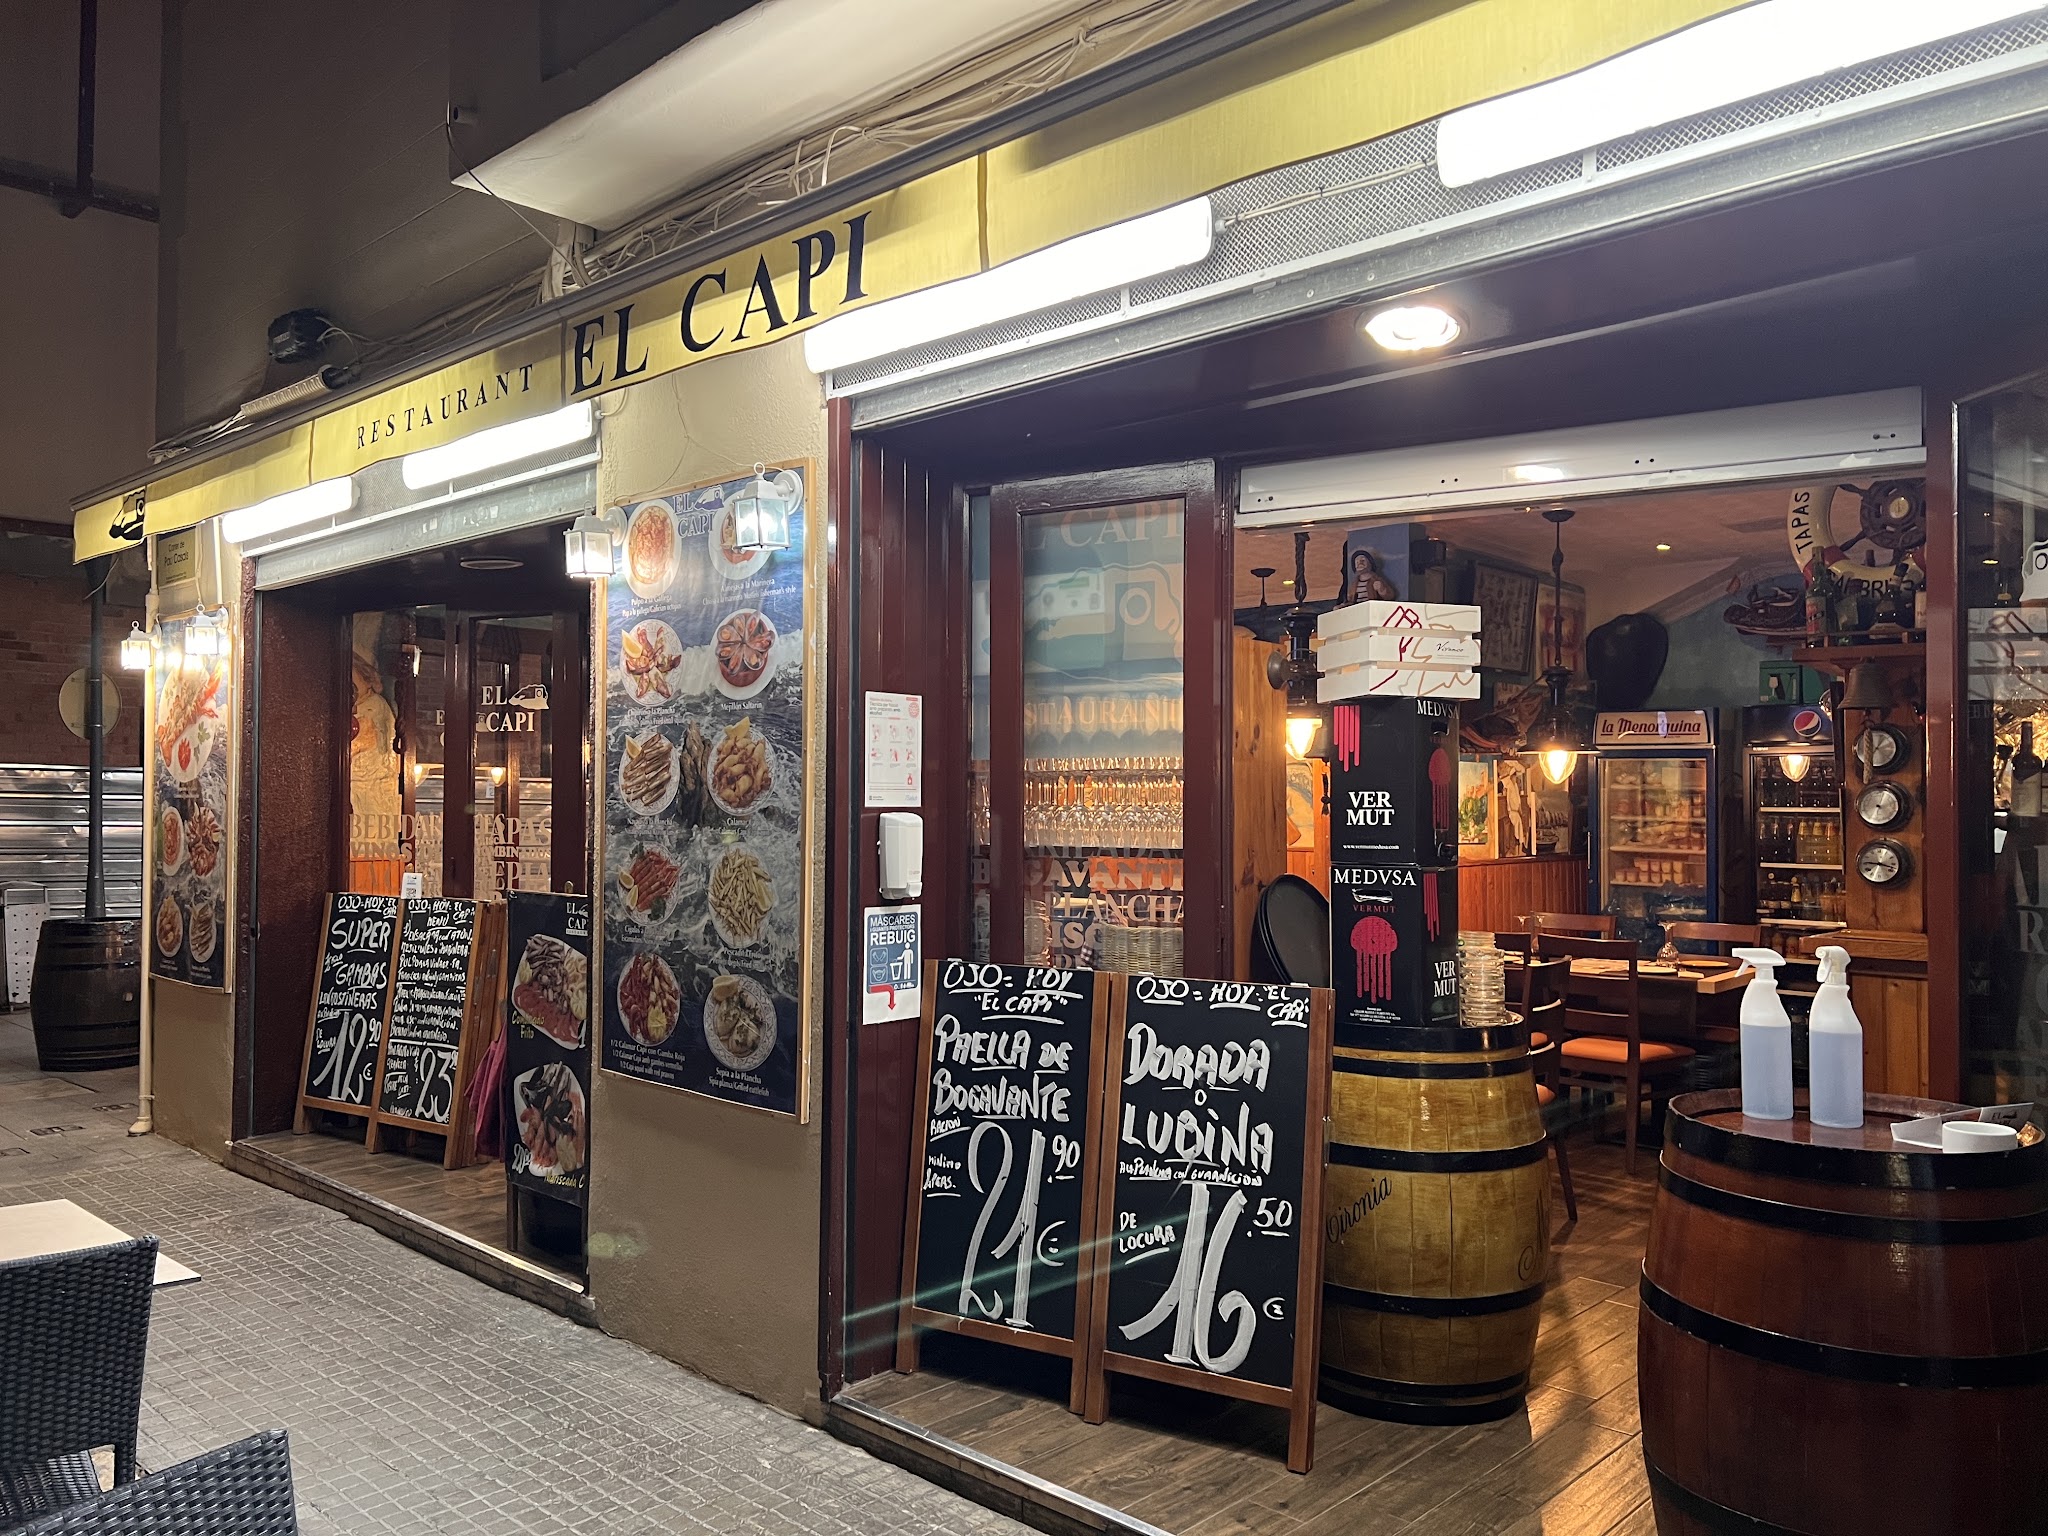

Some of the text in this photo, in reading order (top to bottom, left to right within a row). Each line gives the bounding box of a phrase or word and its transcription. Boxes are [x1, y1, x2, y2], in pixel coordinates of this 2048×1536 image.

[570, 210, 872, 396] EL CAPI
[357, 364, 533, 450] RESTAURANT
[673, 492, 694, 515] EL
[678, 513, 714, 538] CAPI
[1791, 491, 1813, 555] TAPAS
[481, 685, 508, 706] EL
[486, 712, 535, 732] CAPI
[1602, 719, 1614, 733] la
[1348, 791, 1392, 808] VER
[1346, 809, 1395, 826] MUT
[1334, 869, 1417, 886] MEDVSA
[567, 902, 578, 915] EL
[1352, 904, 1396, 913] VERMUT
[331, 916, 391, 952] SUPER
[870, 930, 915, 946] REBUIG
[336, 962, 387, 989] GAMBAS
[1026, 967, 1073, 991] HOY
[1434, 960, 1456, 979] VER
[1433, 978, 1457, 998] MUT
[935, 1014, 1073, 1071] PAELLA DE
[1123, 1023, 1270, 1092] DORADA
[933, 1067, 1071, 1122] BOGAVANTE
[1120, 1212, 1137, 1231] DE
[1119, 1225, 1176, 1253] LOCURA
